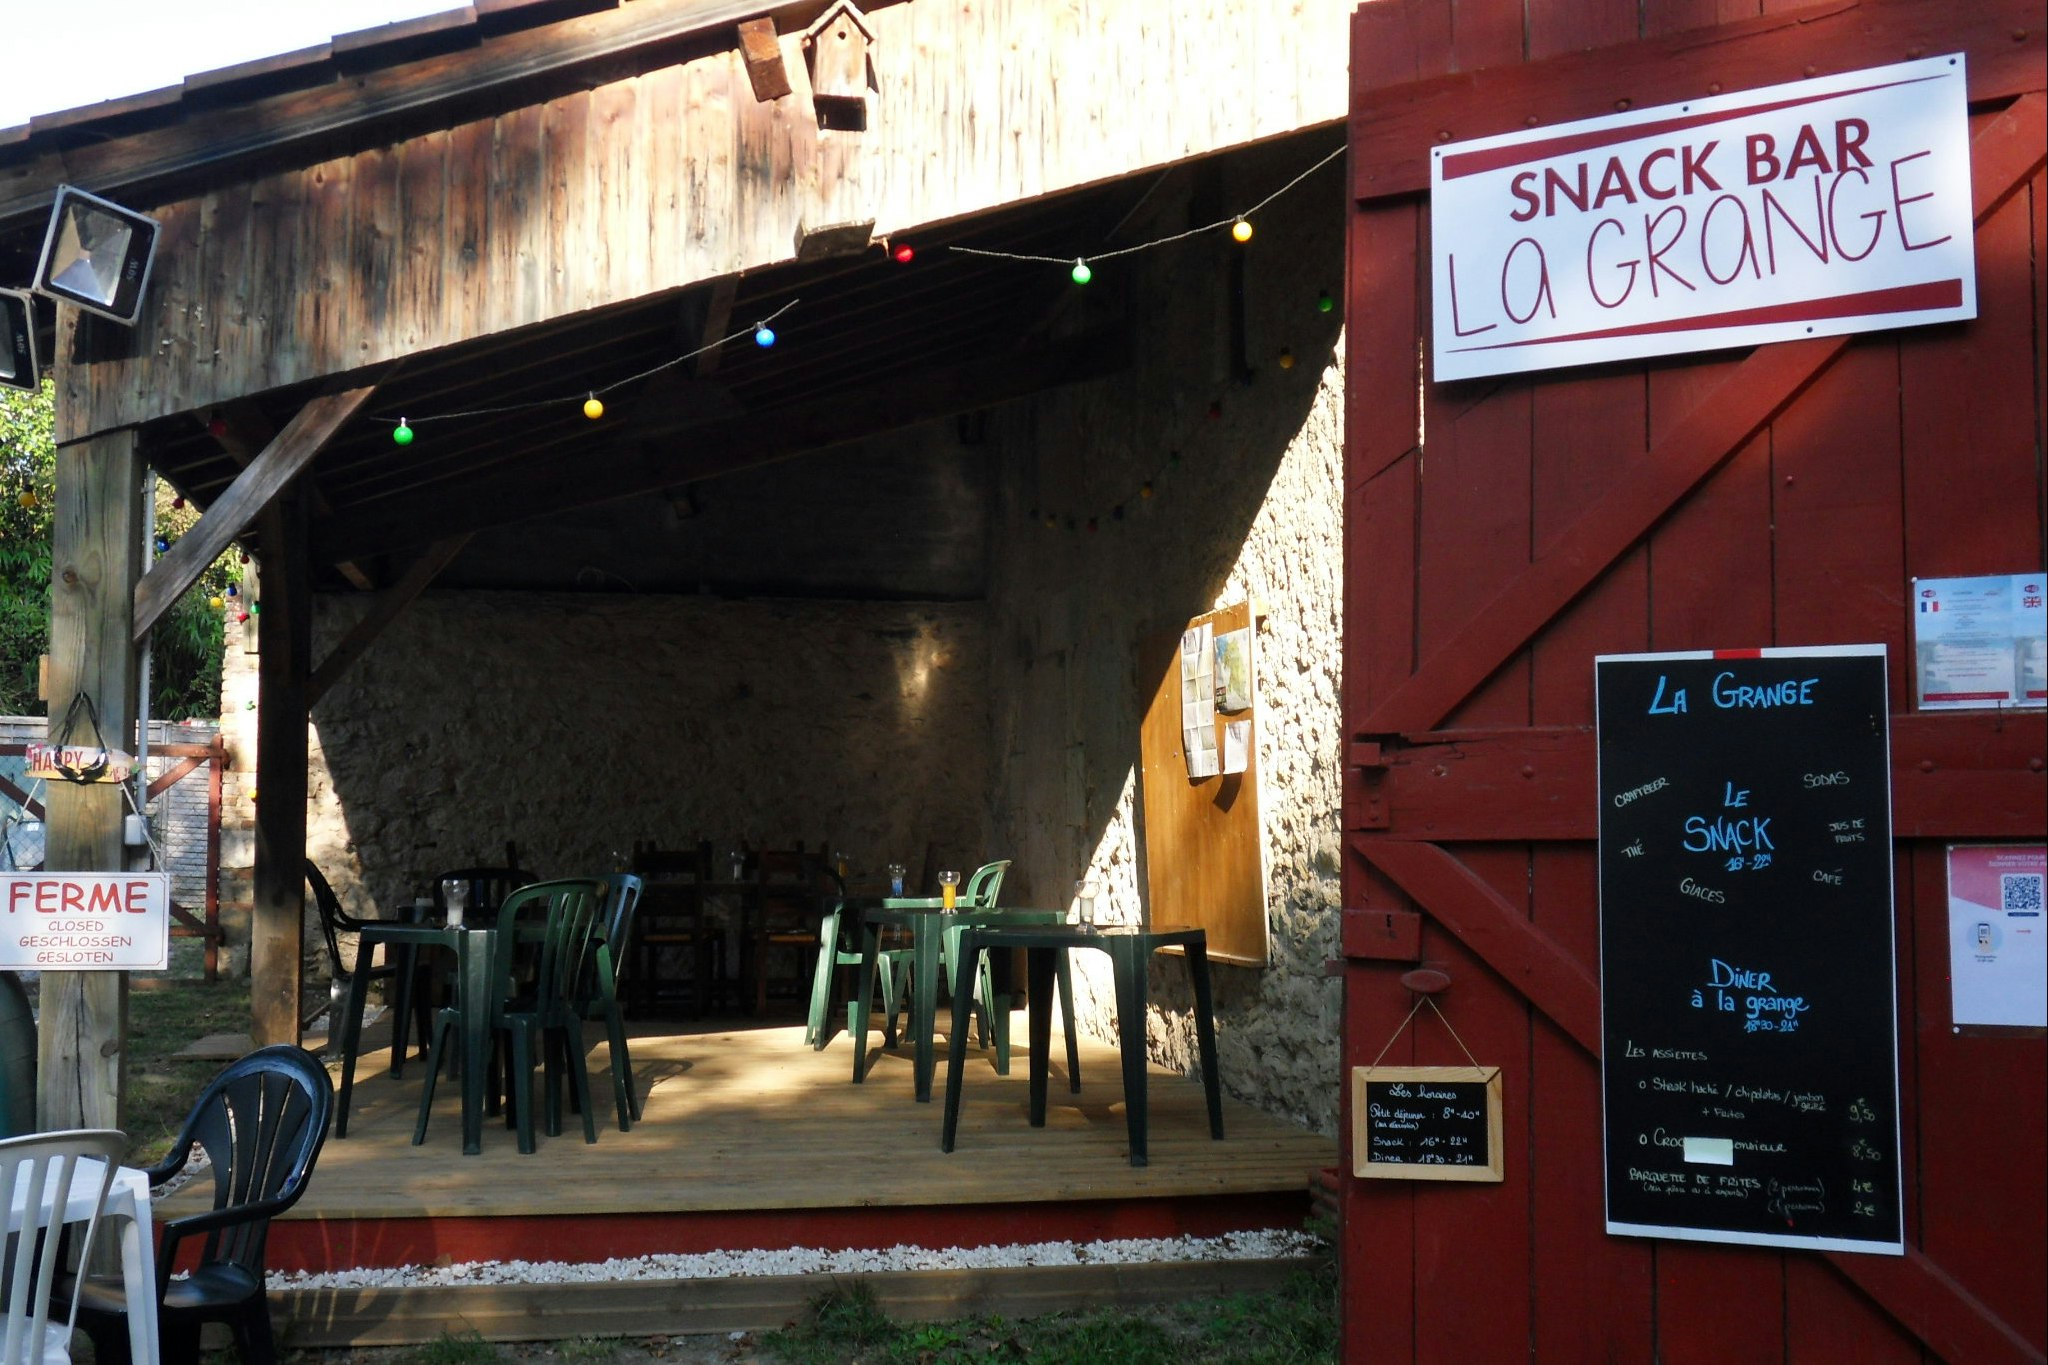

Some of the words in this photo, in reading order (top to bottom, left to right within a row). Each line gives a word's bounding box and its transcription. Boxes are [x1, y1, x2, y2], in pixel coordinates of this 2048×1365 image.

[1509, 140, 1723, 222] SNACK
[1746, 117, 1874, 186] BAR
[1803, 771, 1850, 789] SODAS
[1724, 781, 1750, 807] LE
[1852, 818, 1866, 829] DE
[1683, 815, 1775, 854] SNACK
[1812, 867, 1843, 886] CAFÉ
[9, 881, 150, 914] FERME
[1680, 876, 1726, 904] GLACES
[48, 920, 104, 932] CLOSED
[19, 936, 132, 948] GESCHLOSSEN
[36, 951, 114, 963] GESLOTEN
[1691, 989, 1704, 1008] à
[1718, 989, 1736, 1012] la
[1389, 1083, 1412, 1098] Les
[1417, 1084, 1457, 1100] horaires
[1370, 1103, 1391, 1118] Petit
[1373, 1136, 1405, 1147] Snack
[1696, 1174, 1711, 1186] DE
